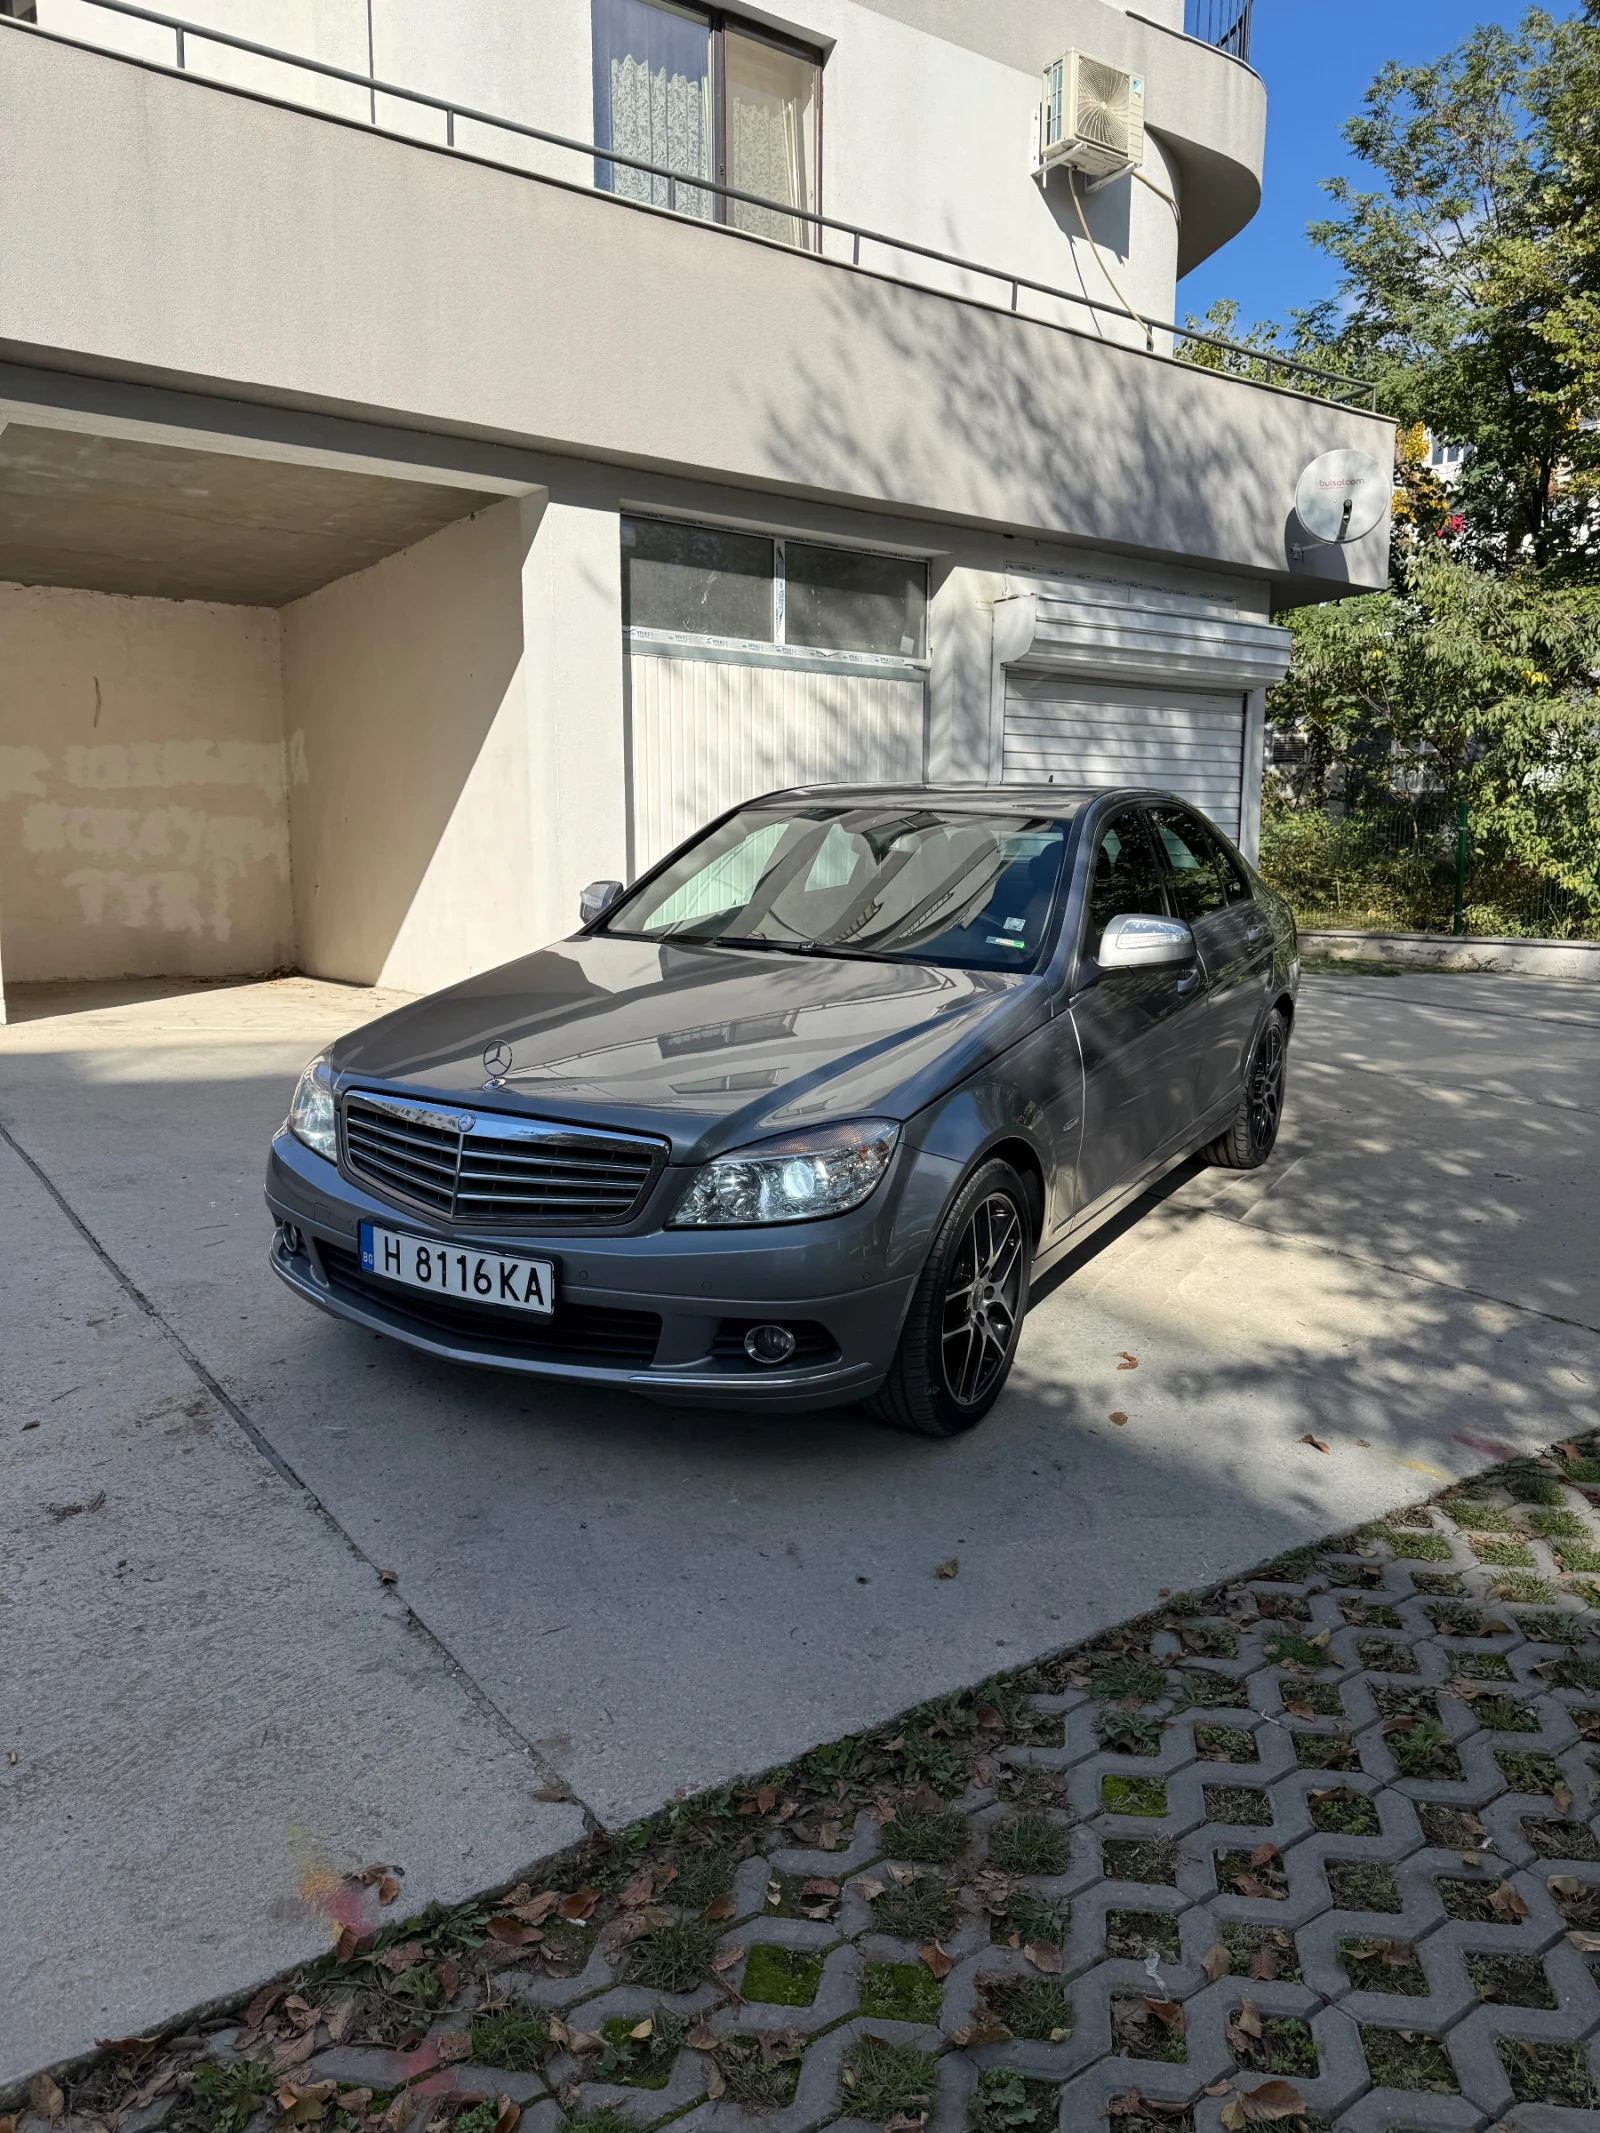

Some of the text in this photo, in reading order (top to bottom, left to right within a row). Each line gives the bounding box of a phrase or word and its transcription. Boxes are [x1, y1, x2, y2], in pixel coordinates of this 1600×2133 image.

[1319, 479, 1365, 487] bulsatcom
[362, 1251, 374, 1264] BG
[385, 1236, 401, 1275] H
